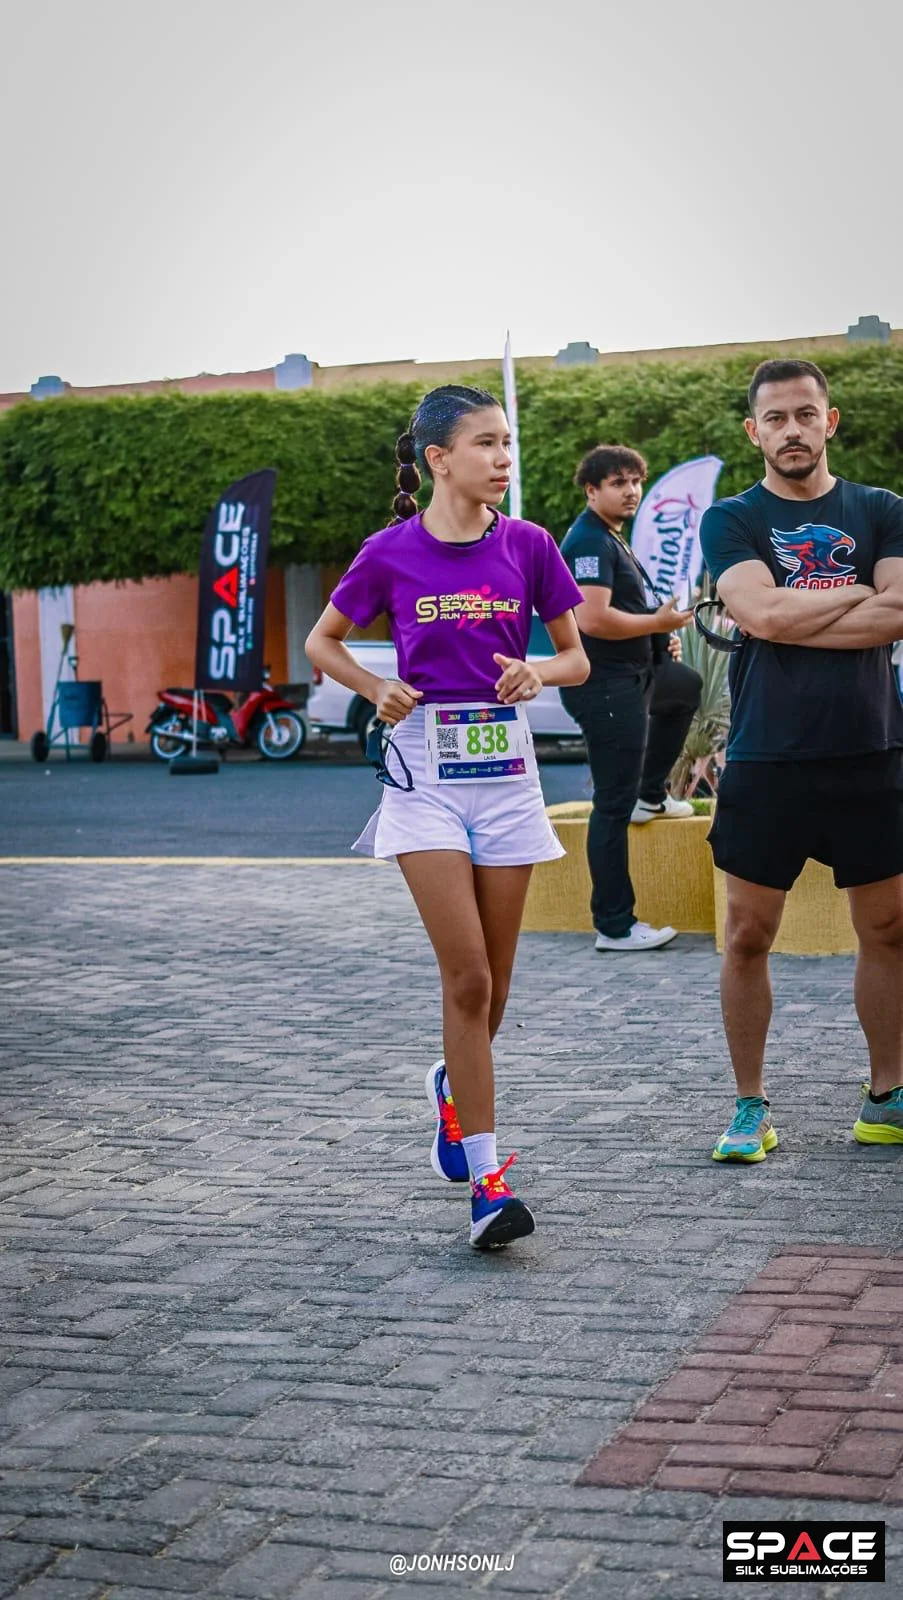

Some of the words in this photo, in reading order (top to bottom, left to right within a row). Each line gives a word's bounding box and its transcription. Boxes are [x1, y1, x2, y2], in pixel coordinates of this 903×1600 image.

[209, 502, 245, 680] SPACE
[439, 601, 492, 613] SPACE
[492, 600, 520, 613] SILK
[439, 612, 461, 620] RUN
[467, 612, 493, 620] 2025
[466, 723, 509, 755] 838
